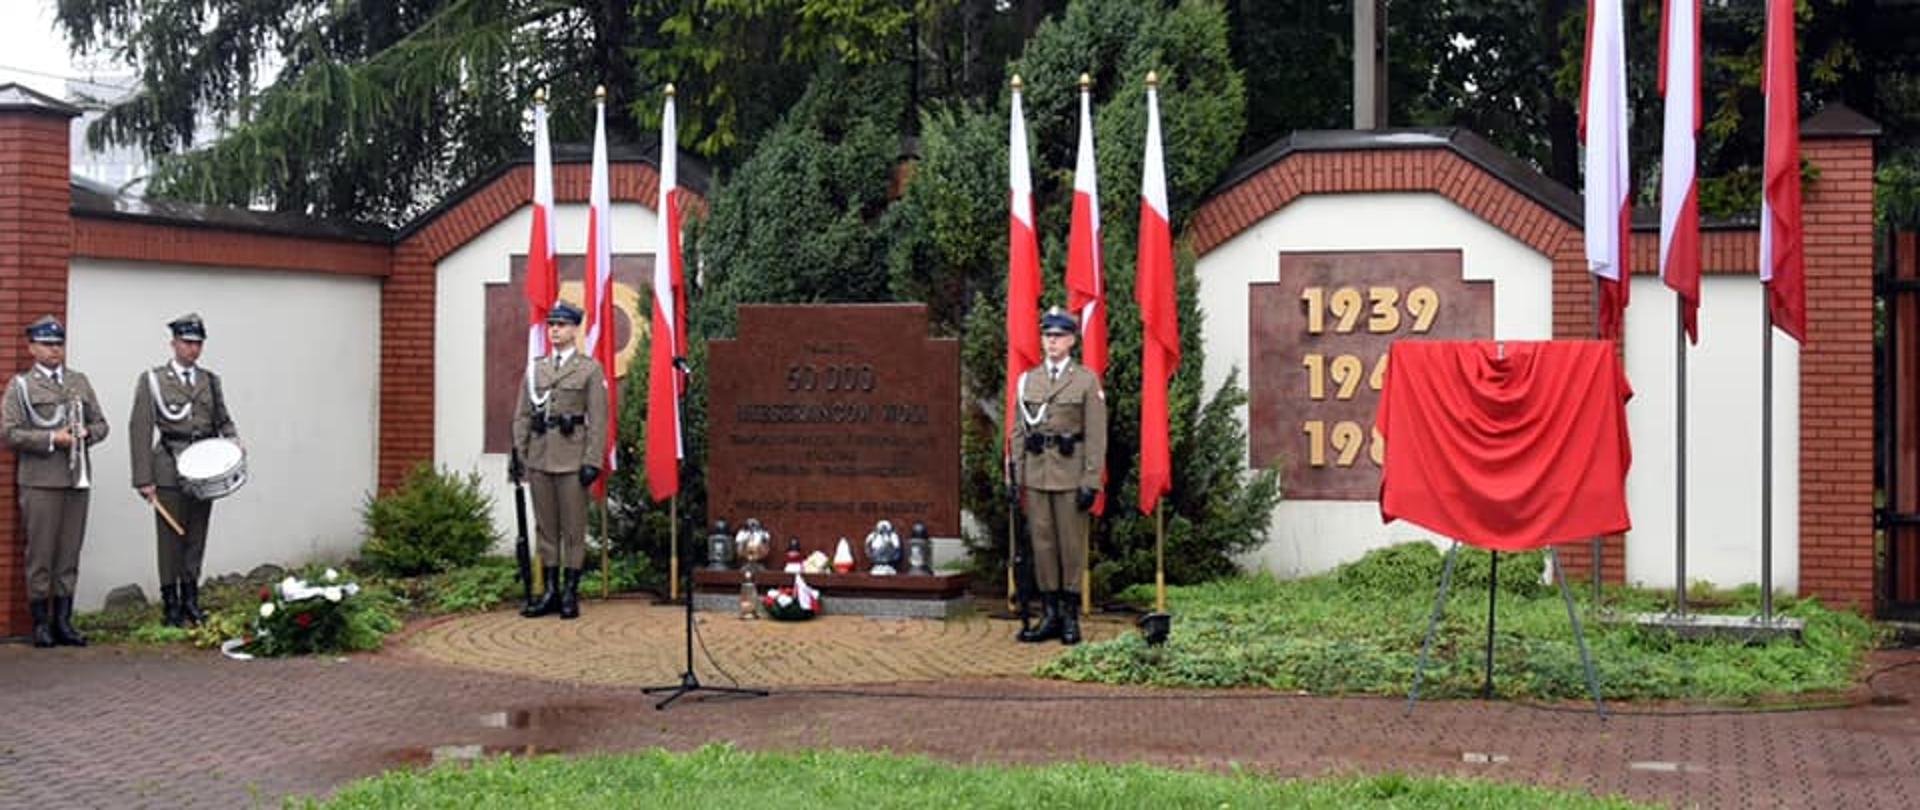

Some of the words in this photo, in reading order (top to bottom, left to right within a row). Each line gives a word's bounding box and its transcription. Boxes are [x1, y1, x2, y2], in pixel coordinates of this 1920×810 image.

[1302, 286, 1440, 334] 1939
[1303, 353, 1389, 400] 19
[1303, 420, 1385, 467] 19
